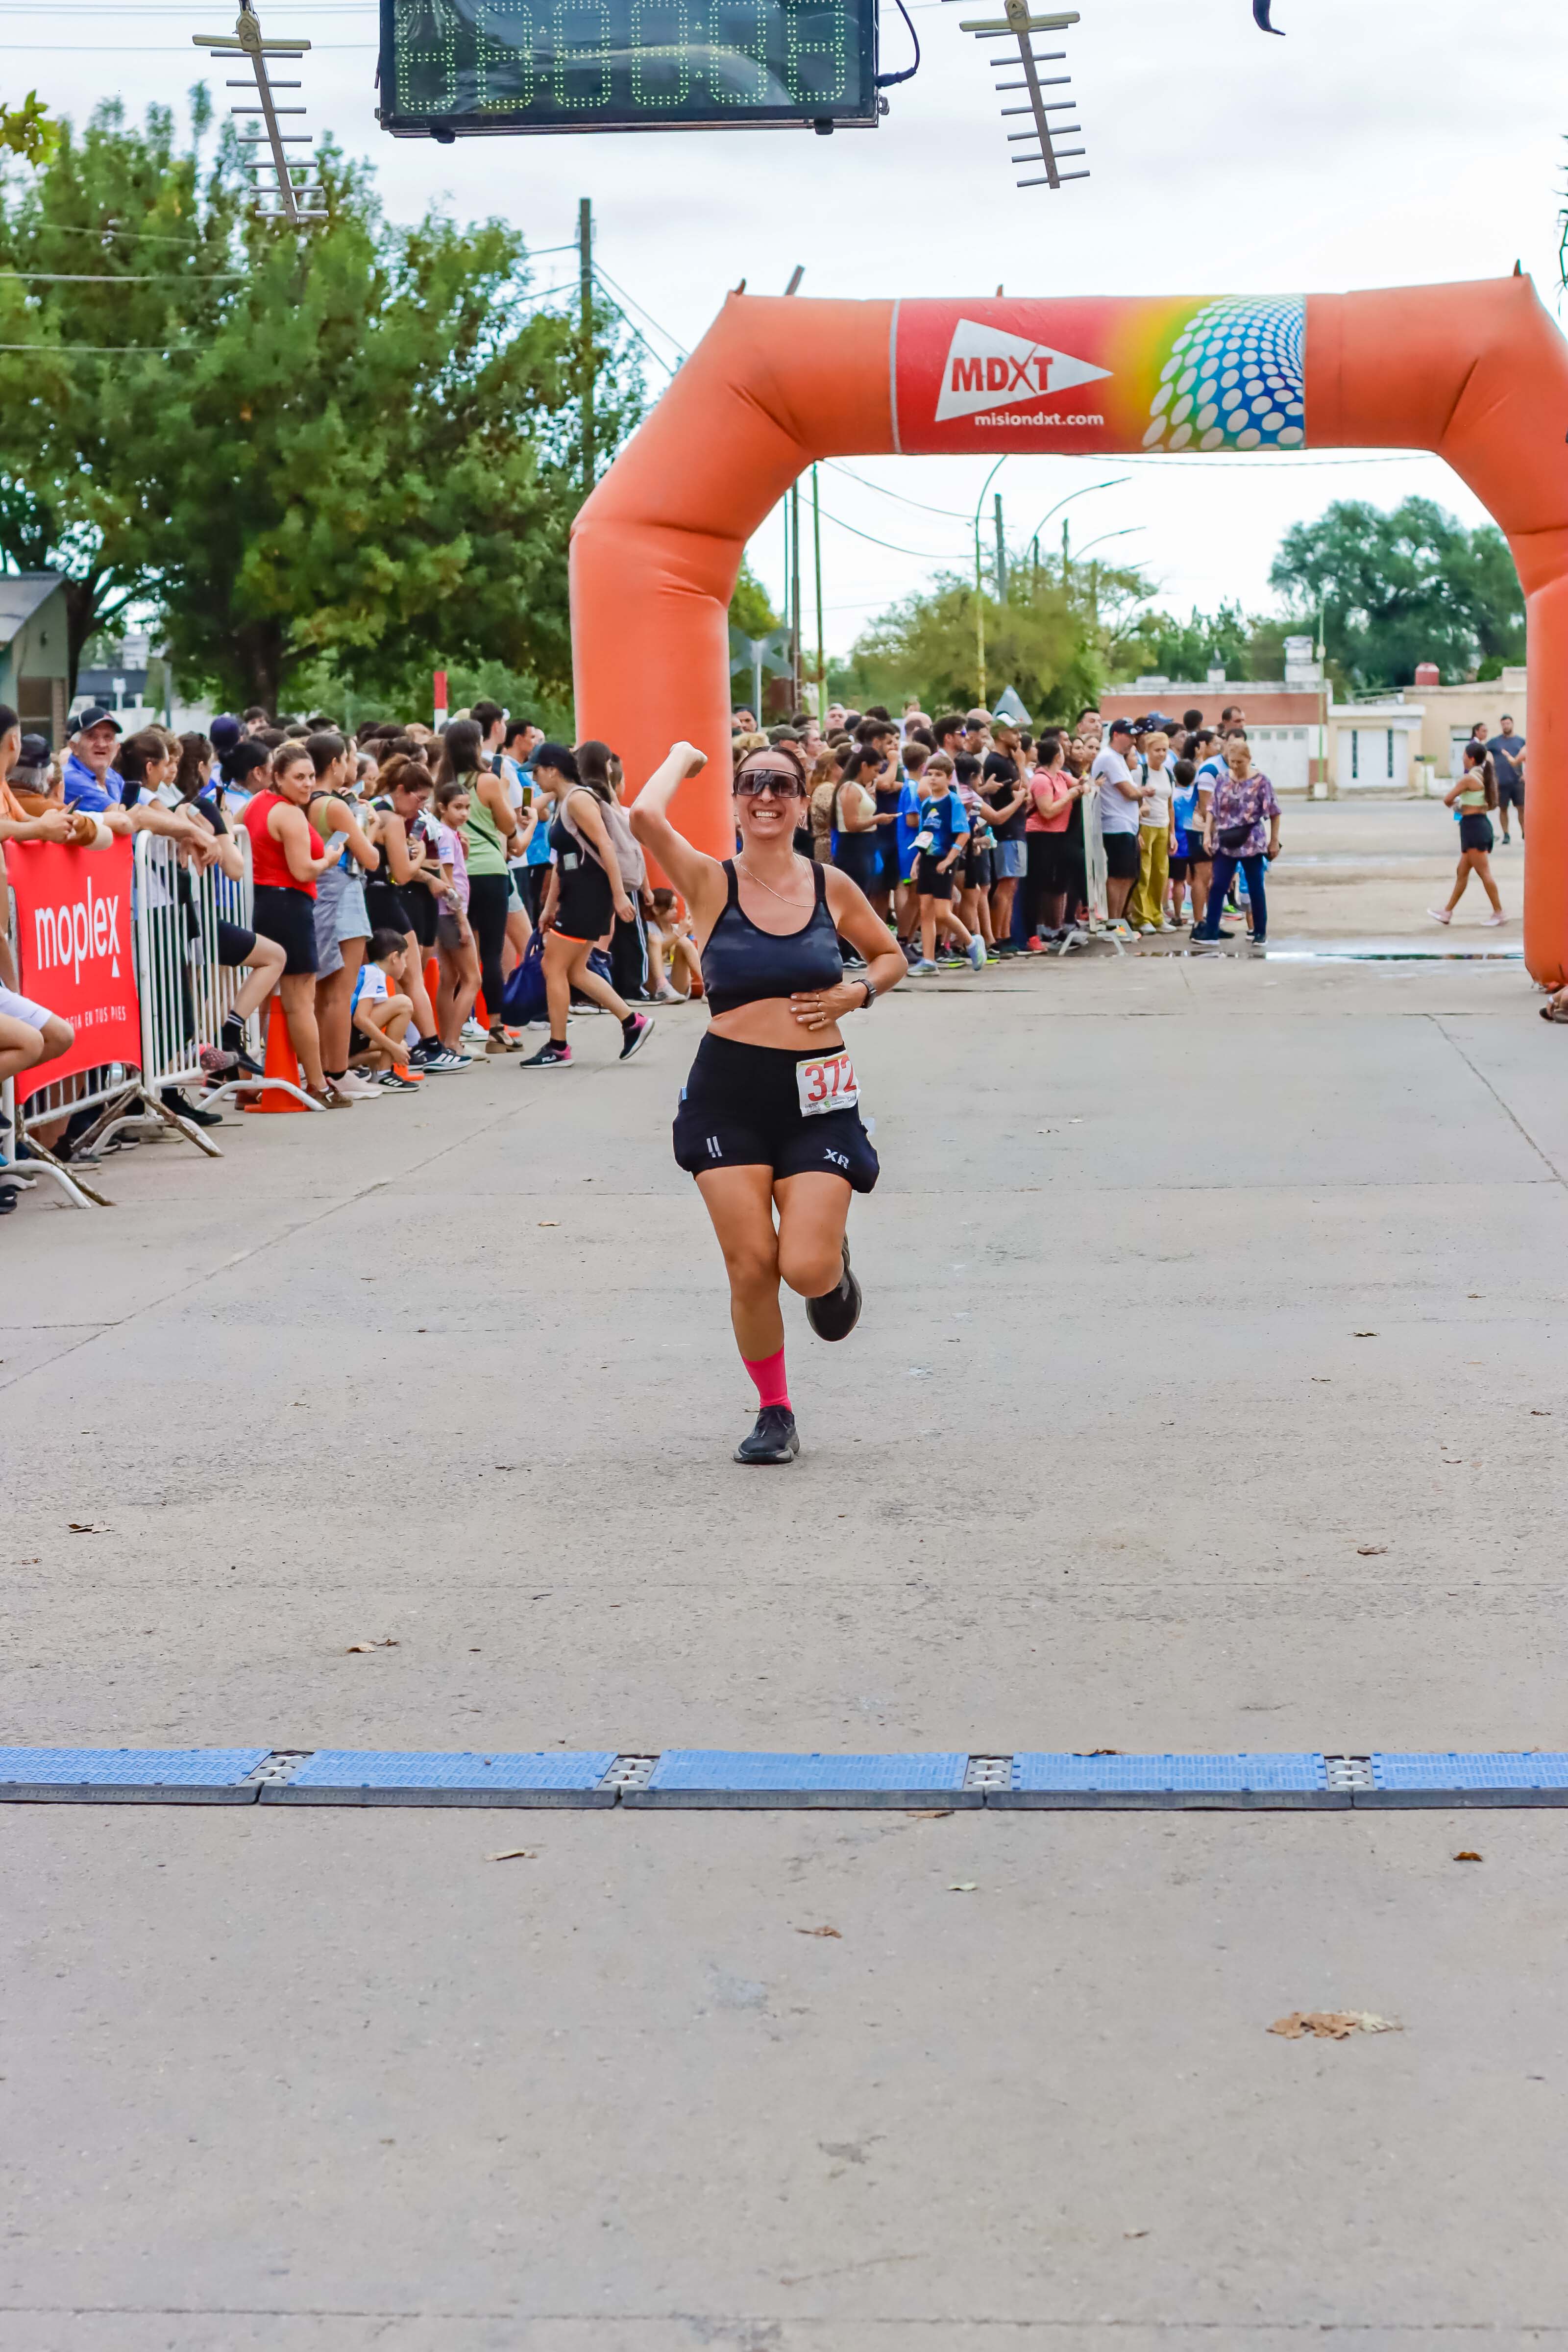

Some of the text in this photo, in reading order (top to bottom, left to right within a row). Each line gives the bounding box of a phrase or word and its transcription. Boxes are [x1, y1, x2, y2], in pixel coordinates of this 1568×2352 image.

[951, 344, 1054, 394] MDXT
[975, 412, 1104, 426] misiondxt.com
[34, 876, 121, 984] moplex
[85, 1011, 93, 1027] EN
[95, 1006, 108, 1023] TUS
[111, 1005, 126, 1022] PIES
[805, 1054, 857, 1102] 372
[823, 1148, 849, 1169] XR
